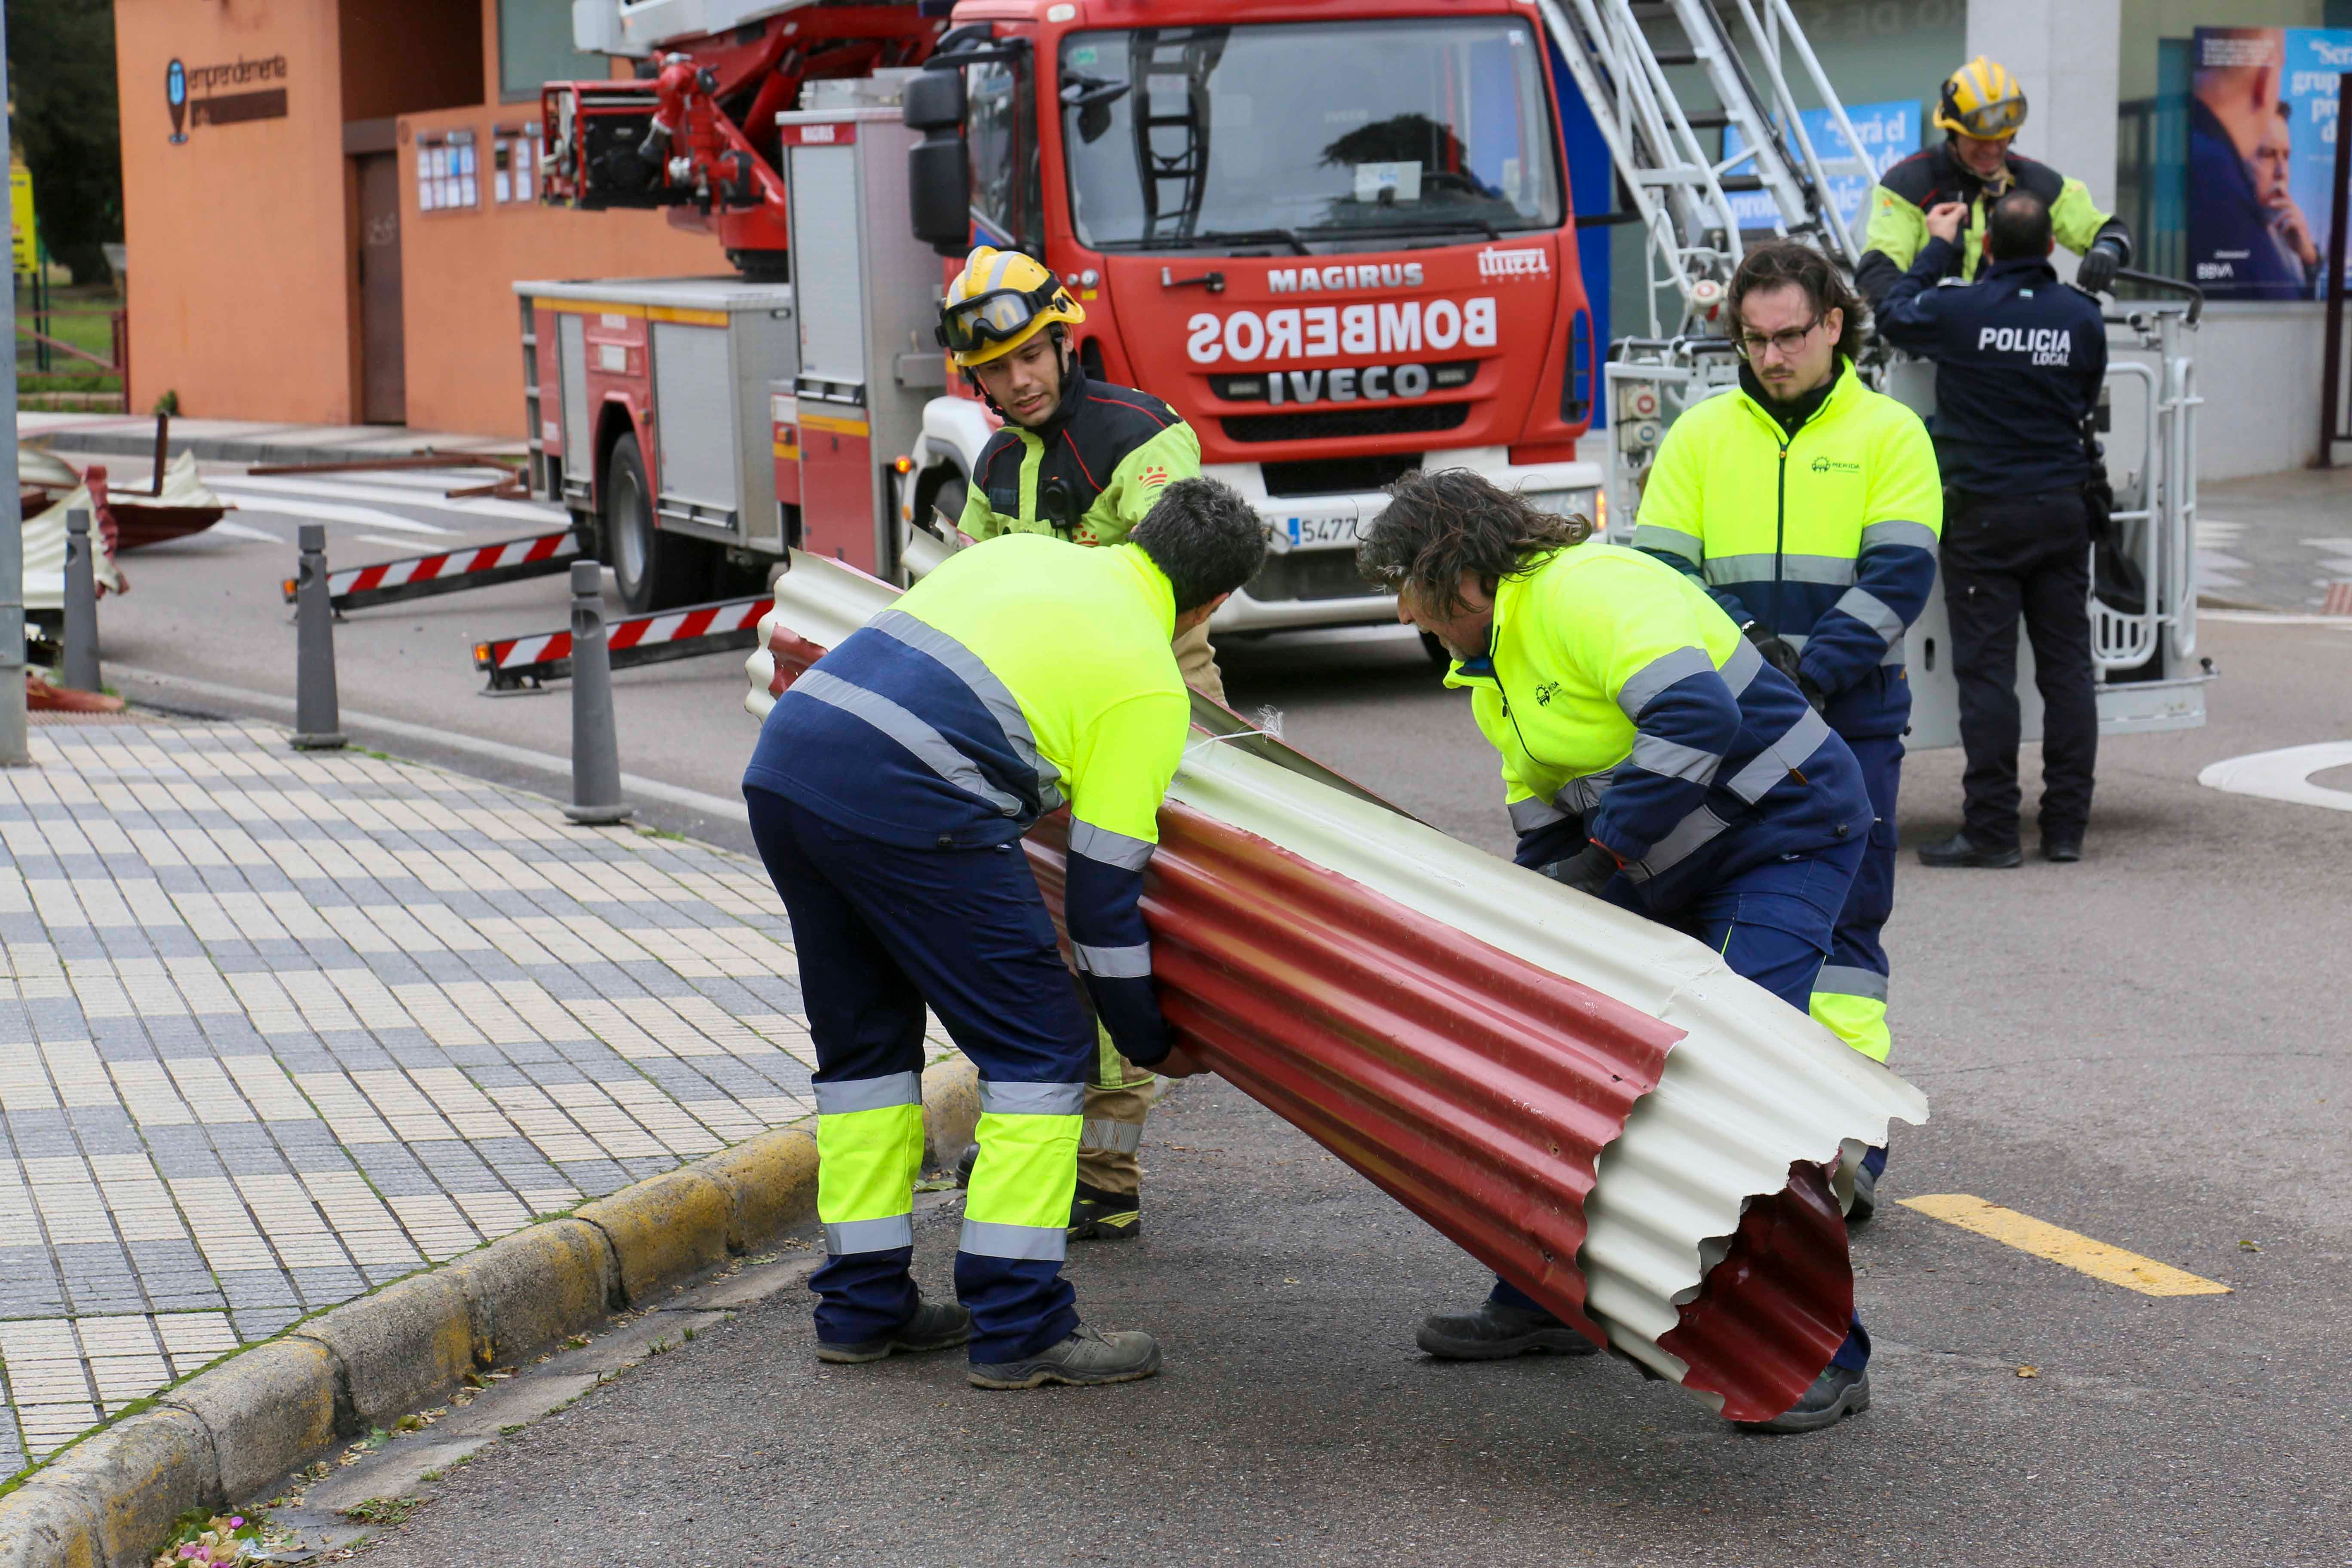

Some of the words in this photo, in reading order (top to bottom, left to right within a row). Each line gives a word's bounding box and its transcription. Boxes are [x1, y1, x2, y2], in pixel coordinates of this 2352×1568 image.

[1268, 263, 1424, 293] MAGIRUS
[2196, 262, 2234, 279] BBVA
[1978, 327, 2071, 352] POLICIA
[2032, 351, 2070, 366] LOCAL
[1267, 364, 1430, 405] IVECO
[1302, 518, 1357, 542] 5477
